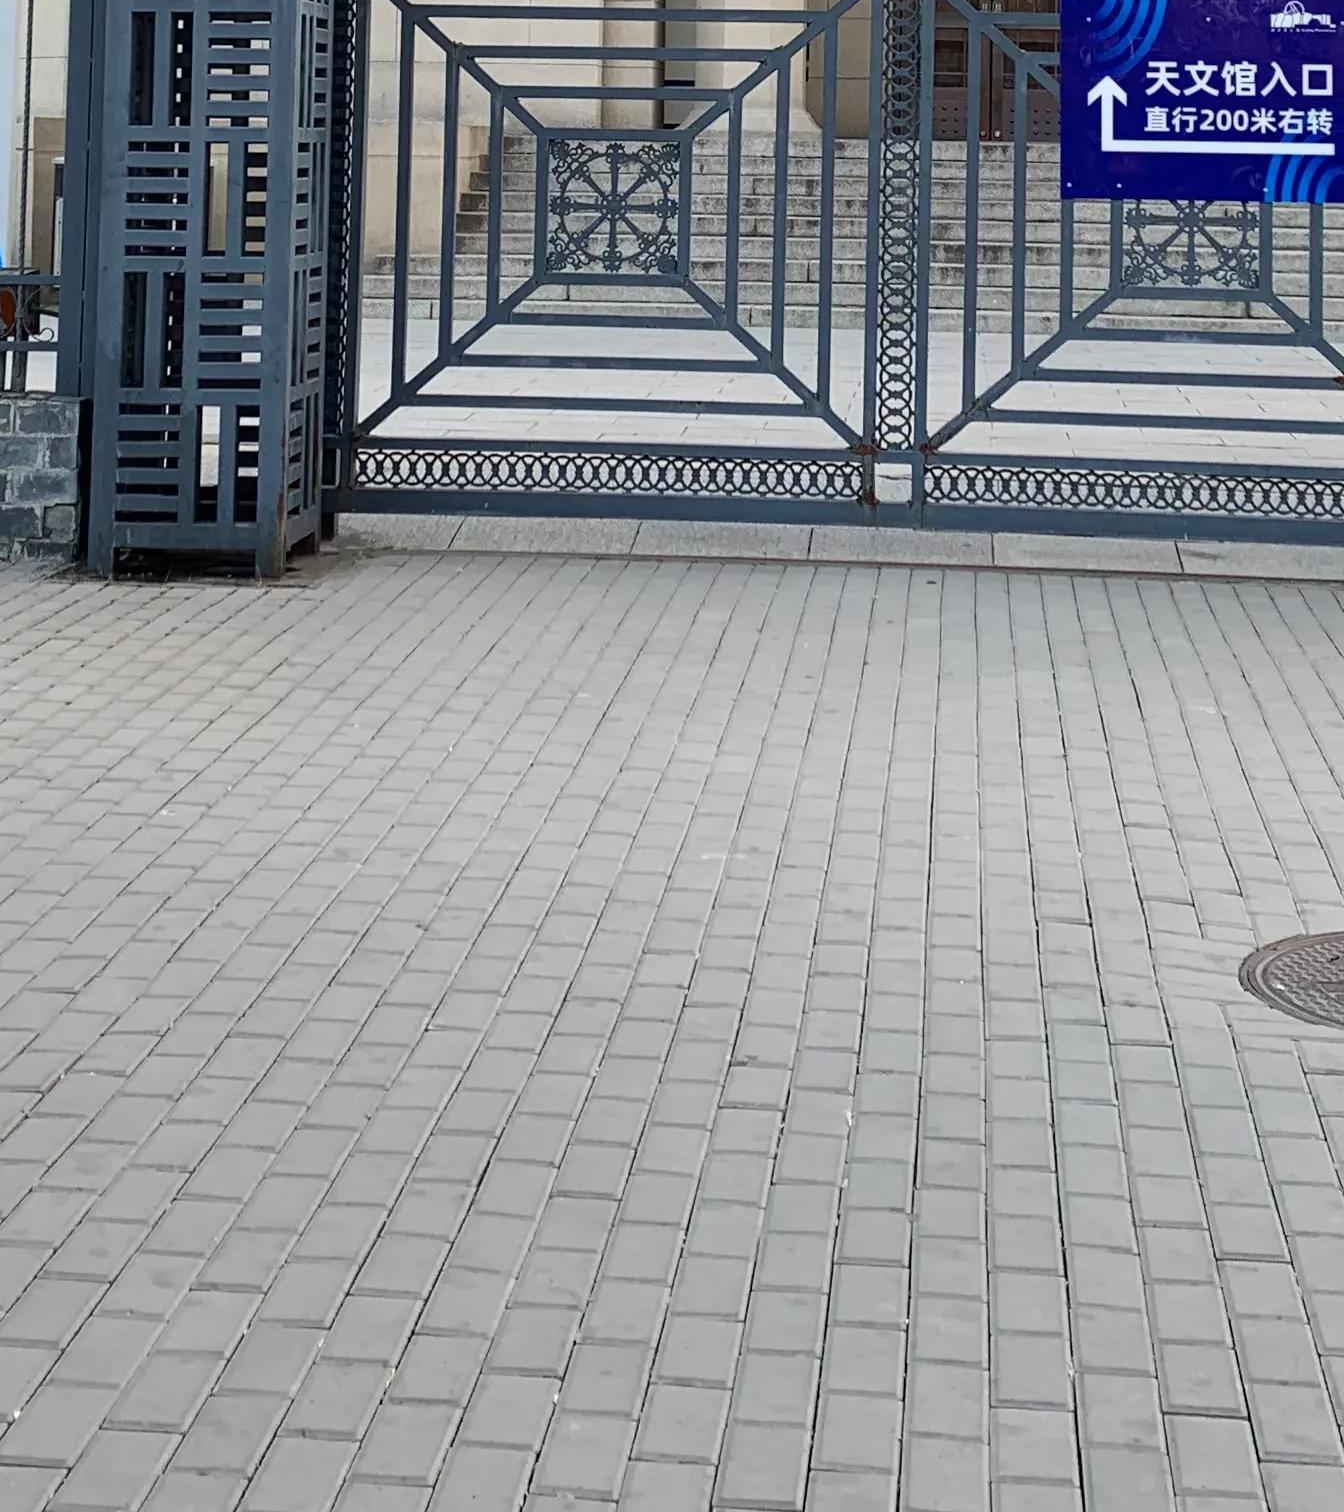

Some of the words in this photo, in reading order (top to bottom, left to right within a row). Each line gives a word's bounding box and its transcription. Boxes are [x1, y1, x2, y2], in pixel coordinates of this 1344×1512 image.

[1145, 60, 1333, 97] 天文馆入口
[1144, 106, 1333, 136] 直行200米右转
